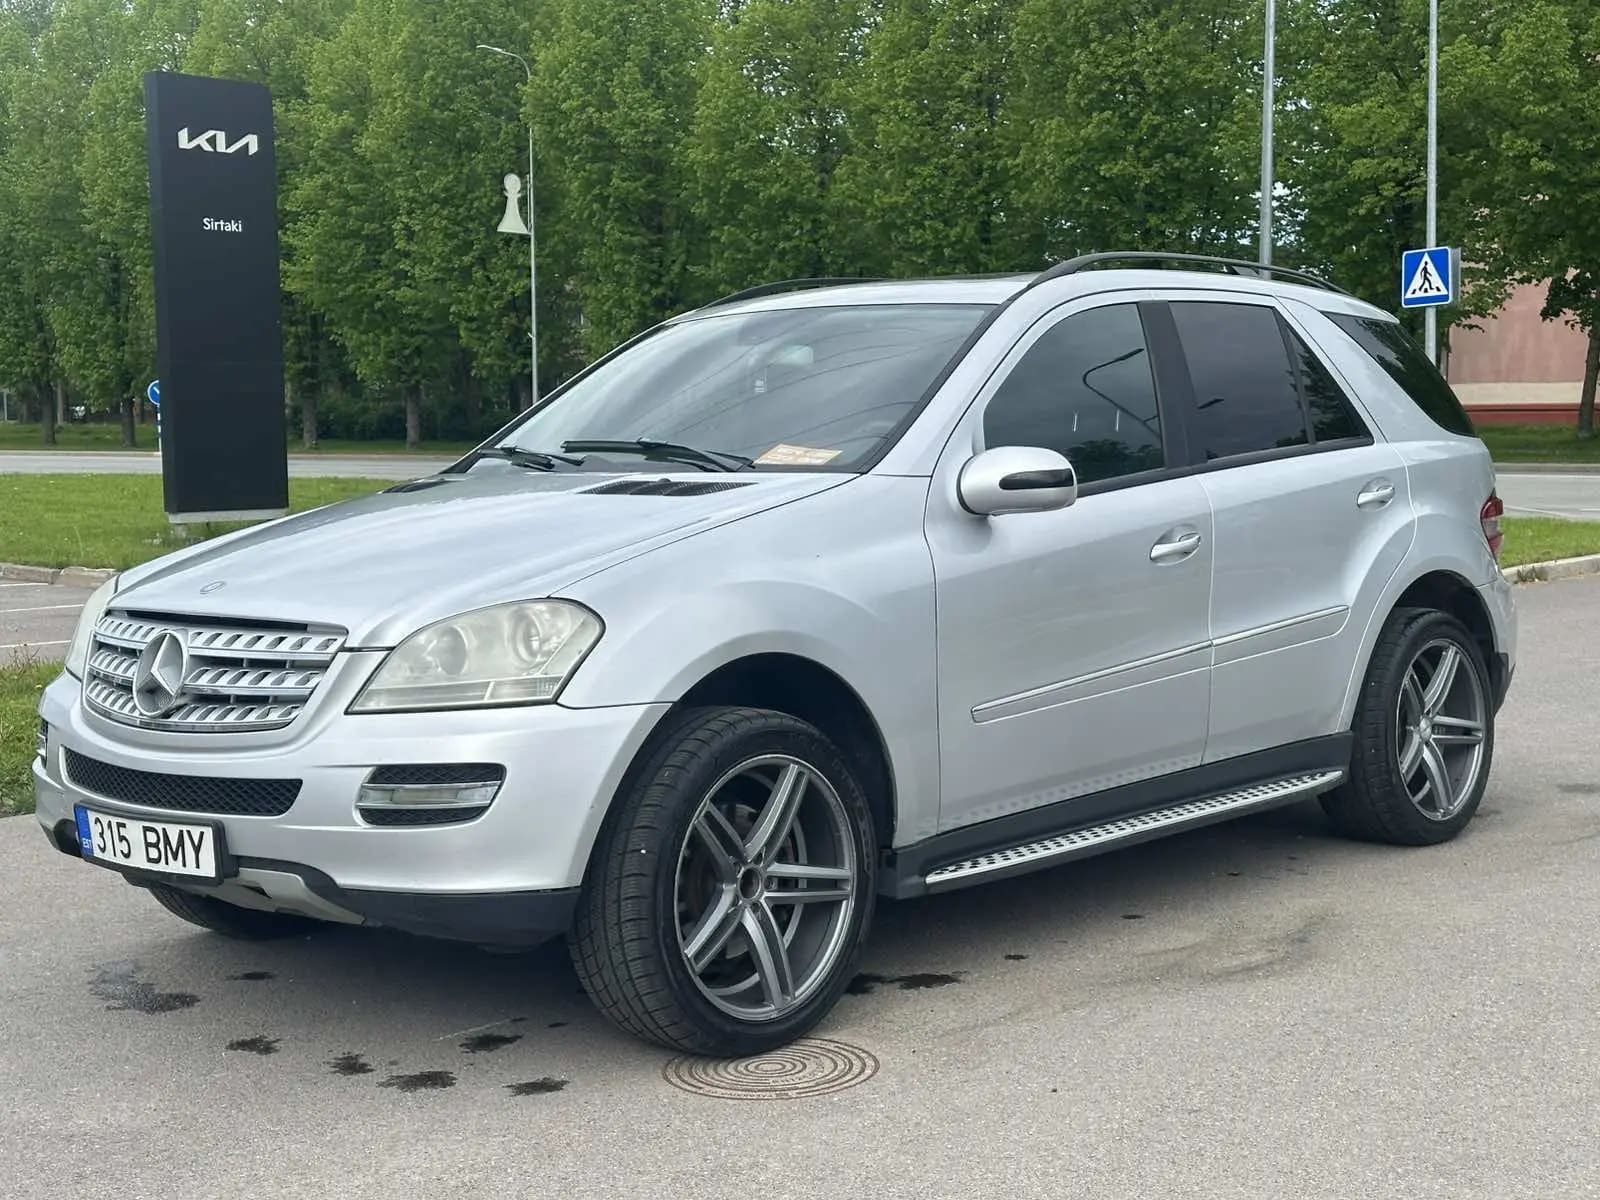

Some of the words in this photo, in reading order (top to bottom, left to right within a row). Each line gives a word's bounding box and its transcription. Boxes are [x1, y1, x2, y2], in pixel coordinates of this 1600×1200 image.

[177, 127, 258, 155] KIA
[203, 217, 242, 232] Sirtaki
[94, 817, 131, 859] 315
[142, 826, 205, 869] BMY
